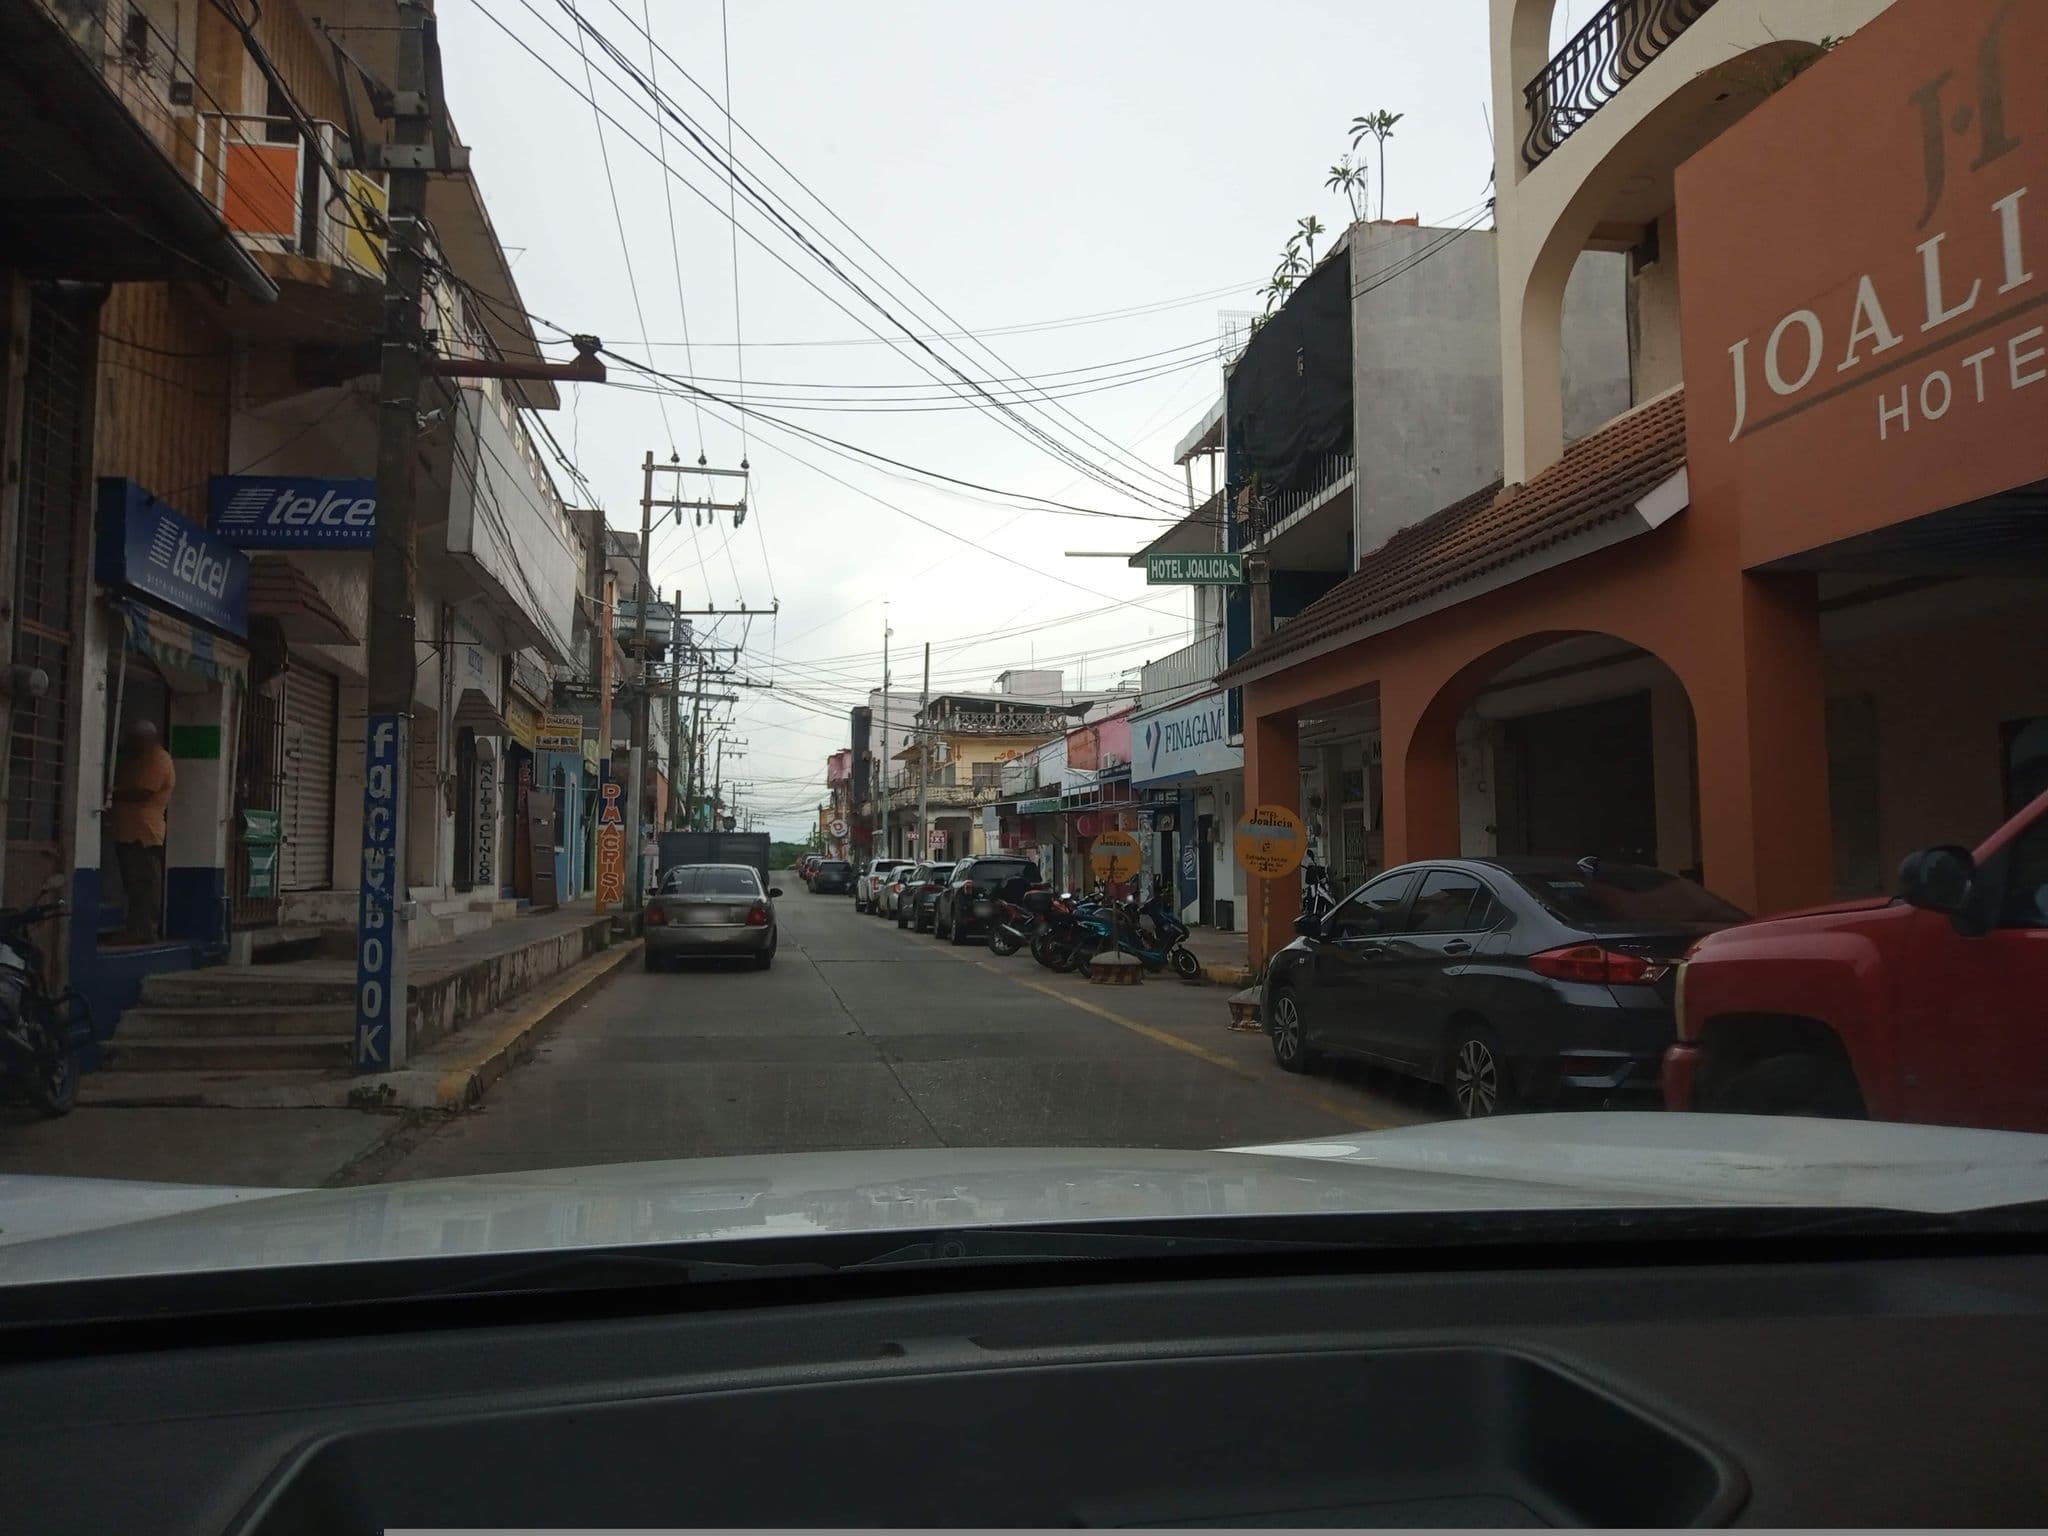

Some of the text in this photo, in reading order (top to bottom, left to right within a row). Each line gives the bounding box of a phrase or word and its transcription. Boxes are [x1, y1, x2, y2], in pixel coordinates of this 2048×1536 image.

[1727, 186, 2035, 444] JOALI
[1877, 324, 2048, 441] HOTE
[266, 489, 376, 527] telce
[172, 530, 232, 600] telcel
[1151, 559, 1230, 579] HOTEL JOALICIA
[1164, 709, 1225, 754] FINAGAM
[601, 783, 623, 903] DIMACRISA
[1249, 808, 1293, 828] Joalicia
